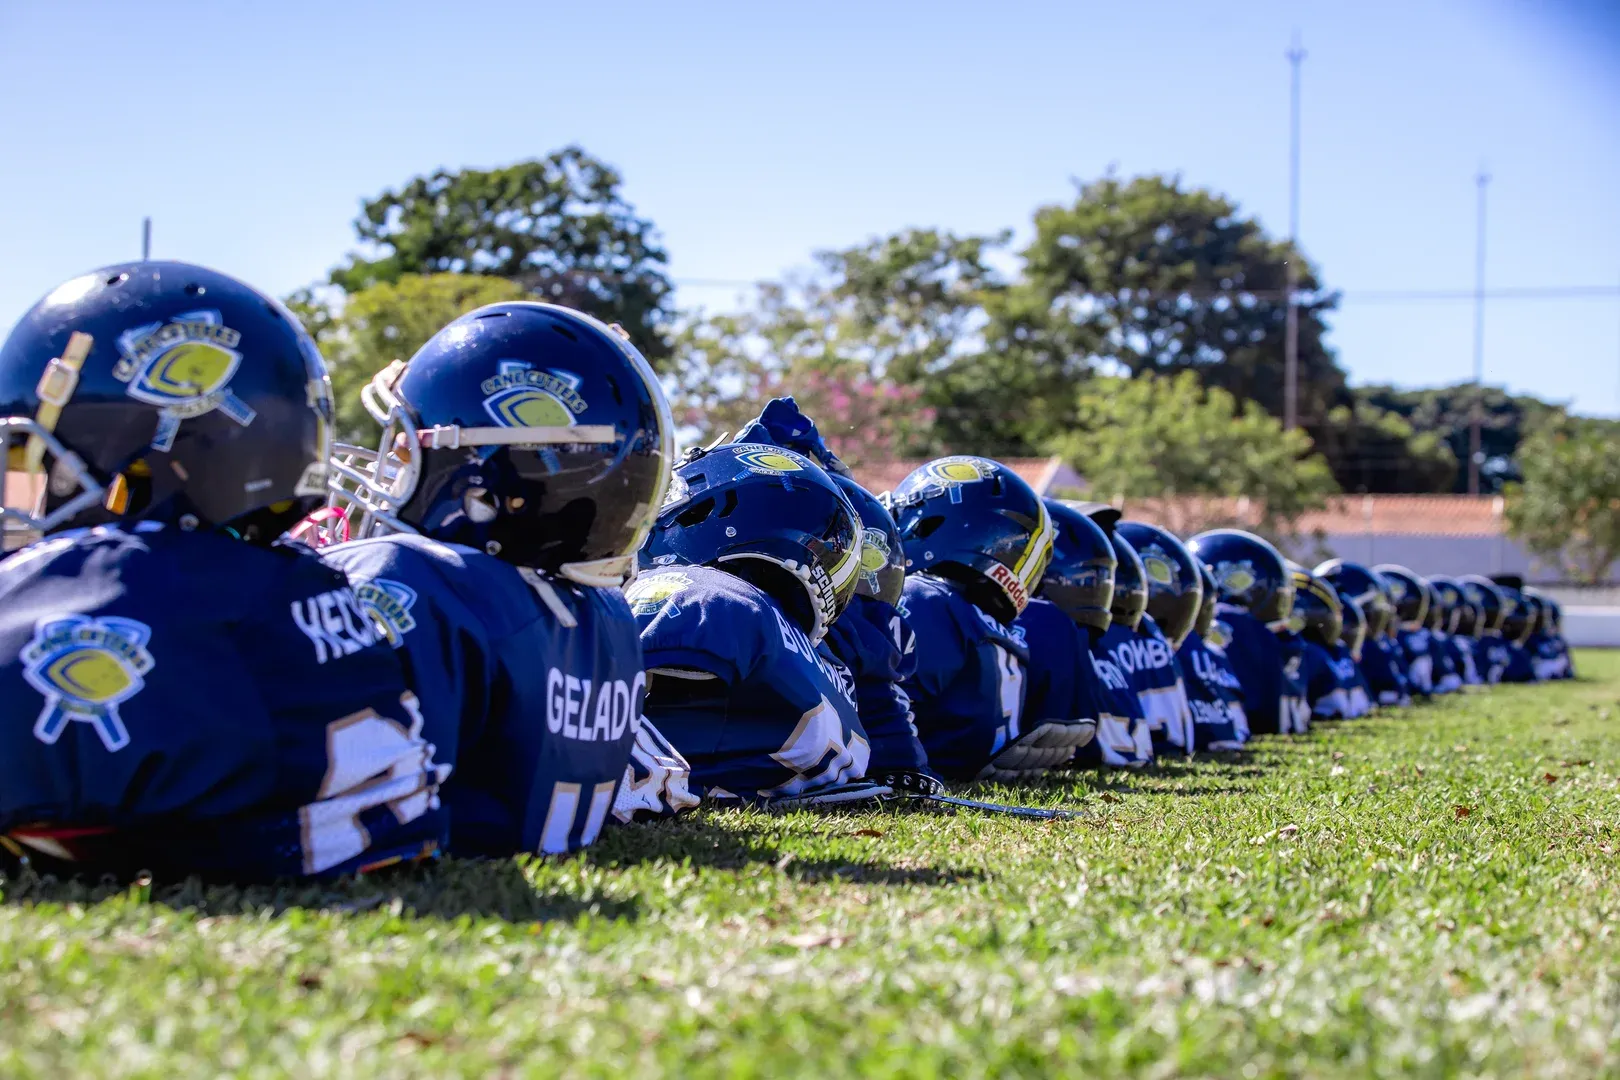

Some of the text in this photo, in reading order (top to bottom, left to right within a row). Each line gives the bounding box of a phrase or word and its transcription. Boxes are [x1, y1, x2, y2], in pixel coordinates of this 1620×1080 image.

[481, 370, 588, 414] CANE CUTTERS
[864, 532, 892, 556] UTTERS
